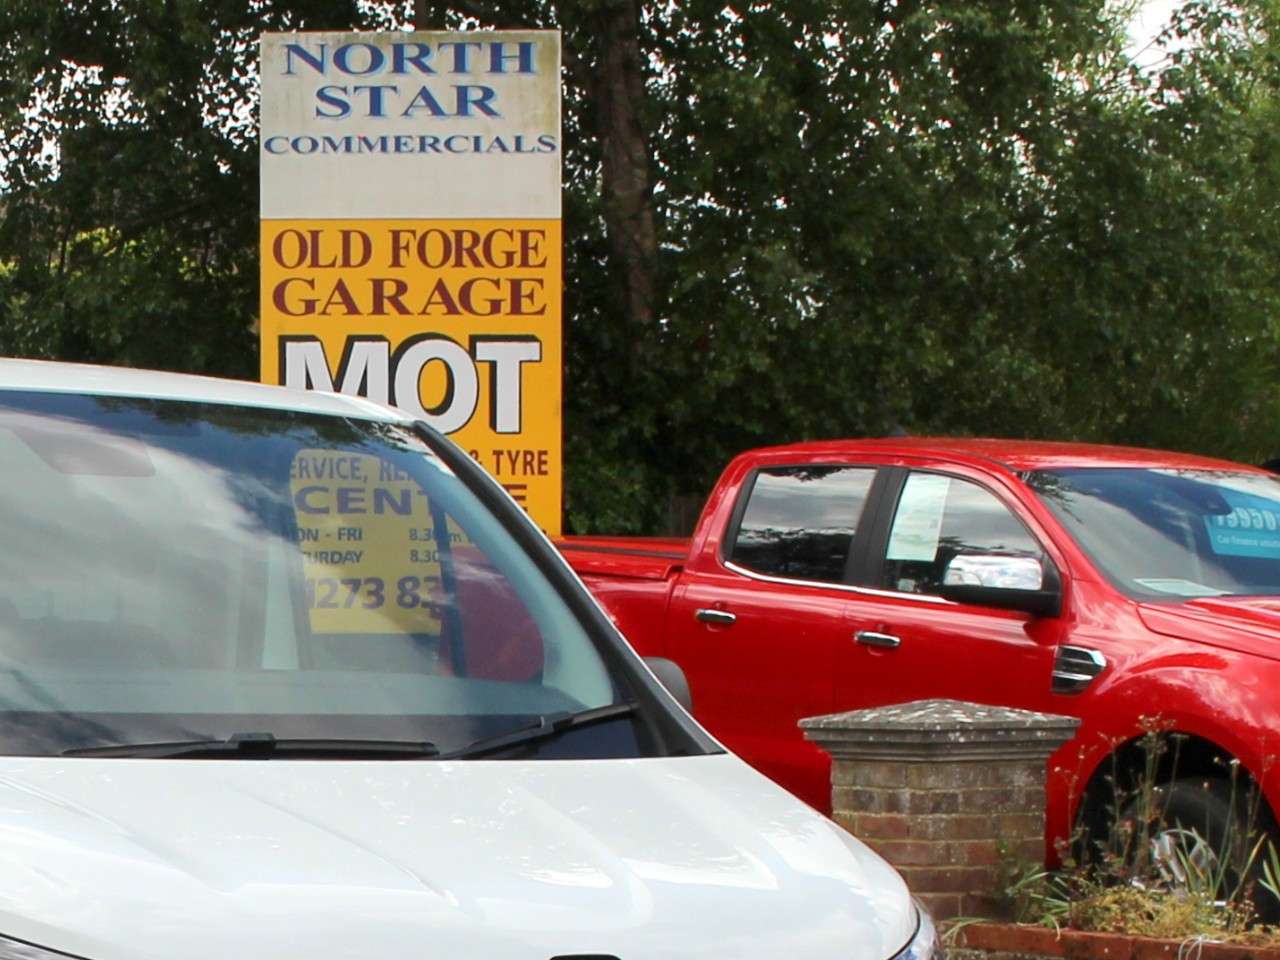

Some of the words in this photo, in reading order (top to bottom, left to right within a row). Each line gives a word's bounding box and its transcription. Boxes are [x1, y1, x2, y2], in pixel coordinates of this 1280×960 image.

[280, 41, 537, 76] NORTH
[313, 84, 504, 119] STAR
[263, 134, 558, 155] COMMERCIALS
[272, 228, 373, 269] OLD
[387, 228, 548, 269] FORGE
[272, 277, 548, 317] GARAGE
[277, 332, 543, 436] MOT
[289, 456, 368, 484] ERVICE,
[492, 449, 549, 476] TYRE
[337, 527, 363, 542] FRI
